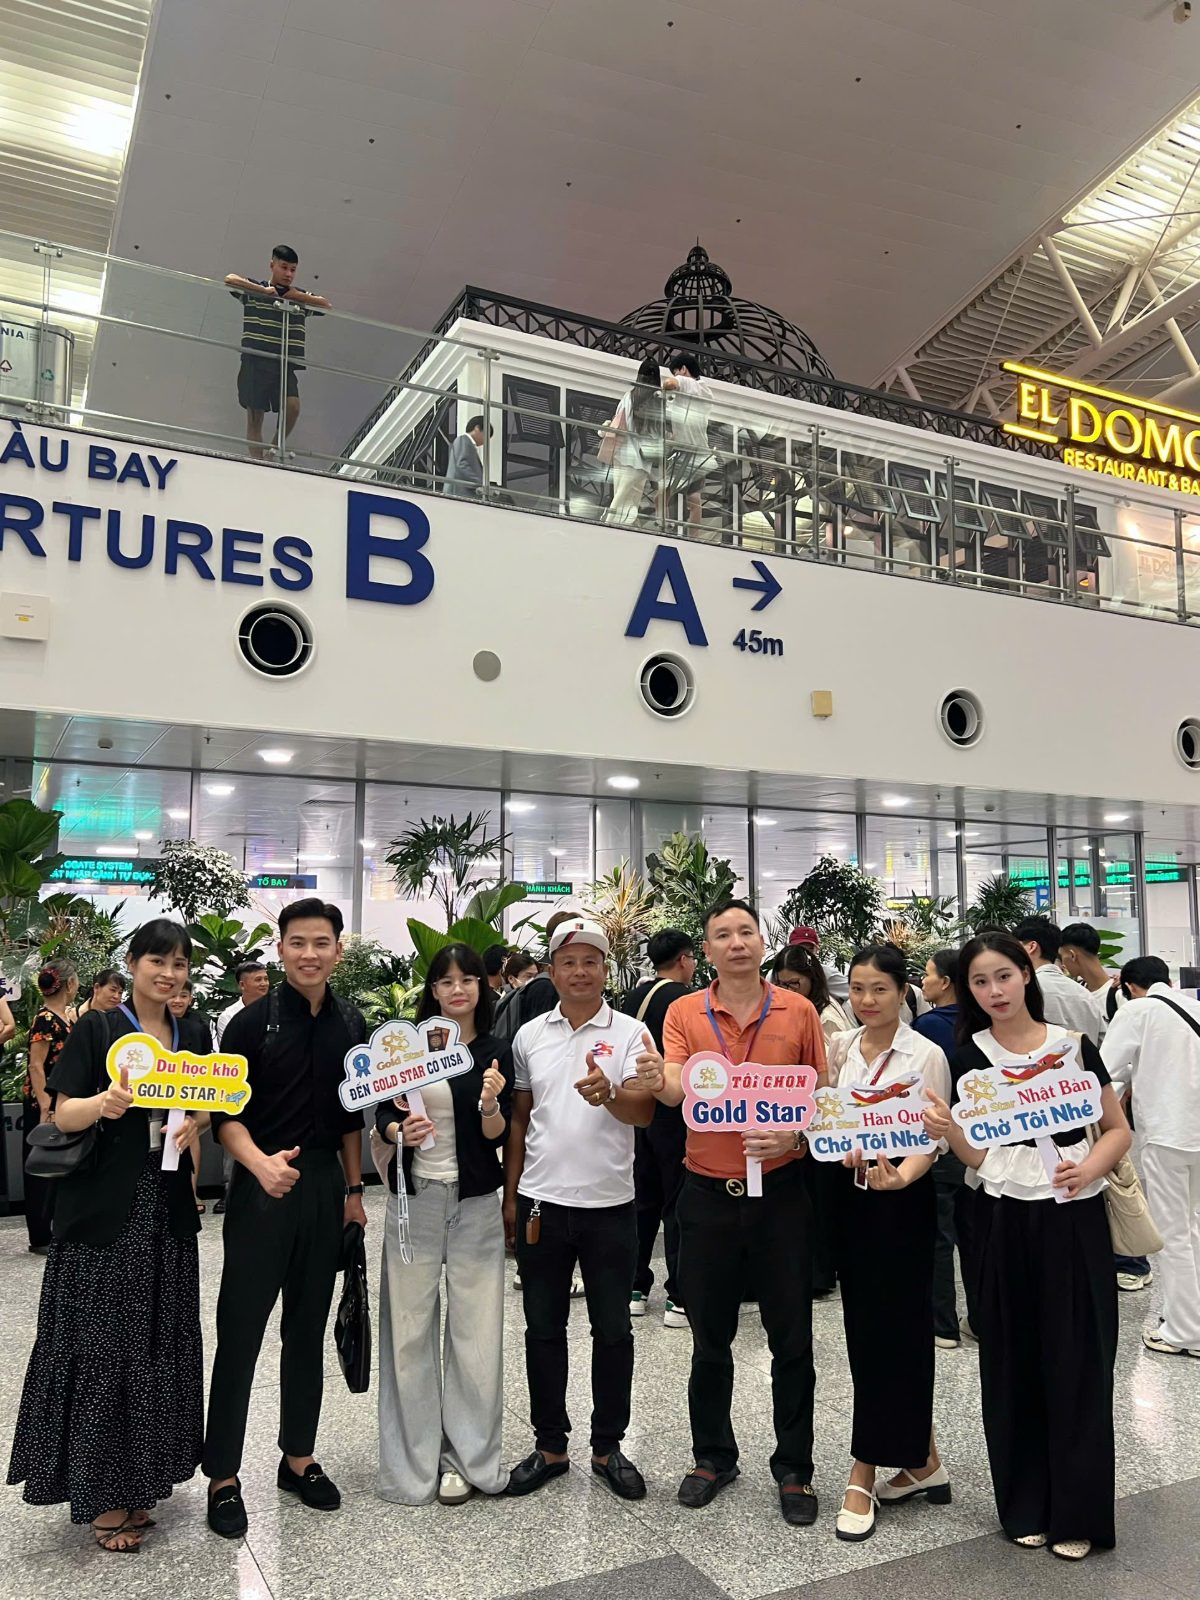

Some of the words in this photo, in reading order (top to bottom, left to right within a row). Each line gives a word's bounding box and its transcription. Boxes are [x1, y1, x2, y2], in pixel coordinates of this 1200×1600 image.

[1020, 382, 1060, 425] EL
[88, 444, 178, 490] BAY
[0, 492, 313, 592] RTURES
[346, 489, 436, 606] B
[624, 544, 709, 647] A
[732, 628, 784, 657] 45m
[60, 860, 95, 870] OGATE
[96, 861, 133, 871] SYSTEM
[271, 878, 288, 886] BAY
[547, 884, 571, 893] KHÁCH
[156, 1059, 176, 1073] Du
[181, 1060, 207, 1078] học
[212, 1062, 239, 1077] khó
[376, 1056, 401, 1071] Gold
[349, 1081, 371, 1101] ĐẾN
[373, 1074, 399, 1093] GOLD
[399, 1065, 426, 1084] STAR
[426, 1057, 439, 1075] CÓ
[440, 1052, 464, 1070] VISA
[763, 1075, 808, 1092] CHỌN
[137, 1083, 175, 1099] GOLD
[180, 1085, 217, 1101] STAR
[1016, 1085, 1057, 1106] Nhật
[1058, 1078, 1093, 1096] Bản
[692, 1099, 747, 1124] Gold
[755, 1100, 807, 1123] Star
[863, 1112, 893, 1127] Hàn
[958, 1105, 988, 1120] Gold
[970, 1118, 1011, 1141] Chờ
[1013, 1109, 1049, 1132] Tôi
[1049, 1099, 1094, 1125] Nhé
[814, 1136, 852, 1154] Chờ
[856, 1131, 887, 1151] Tôi
[890, 1128, 930, 1148] Nhé
